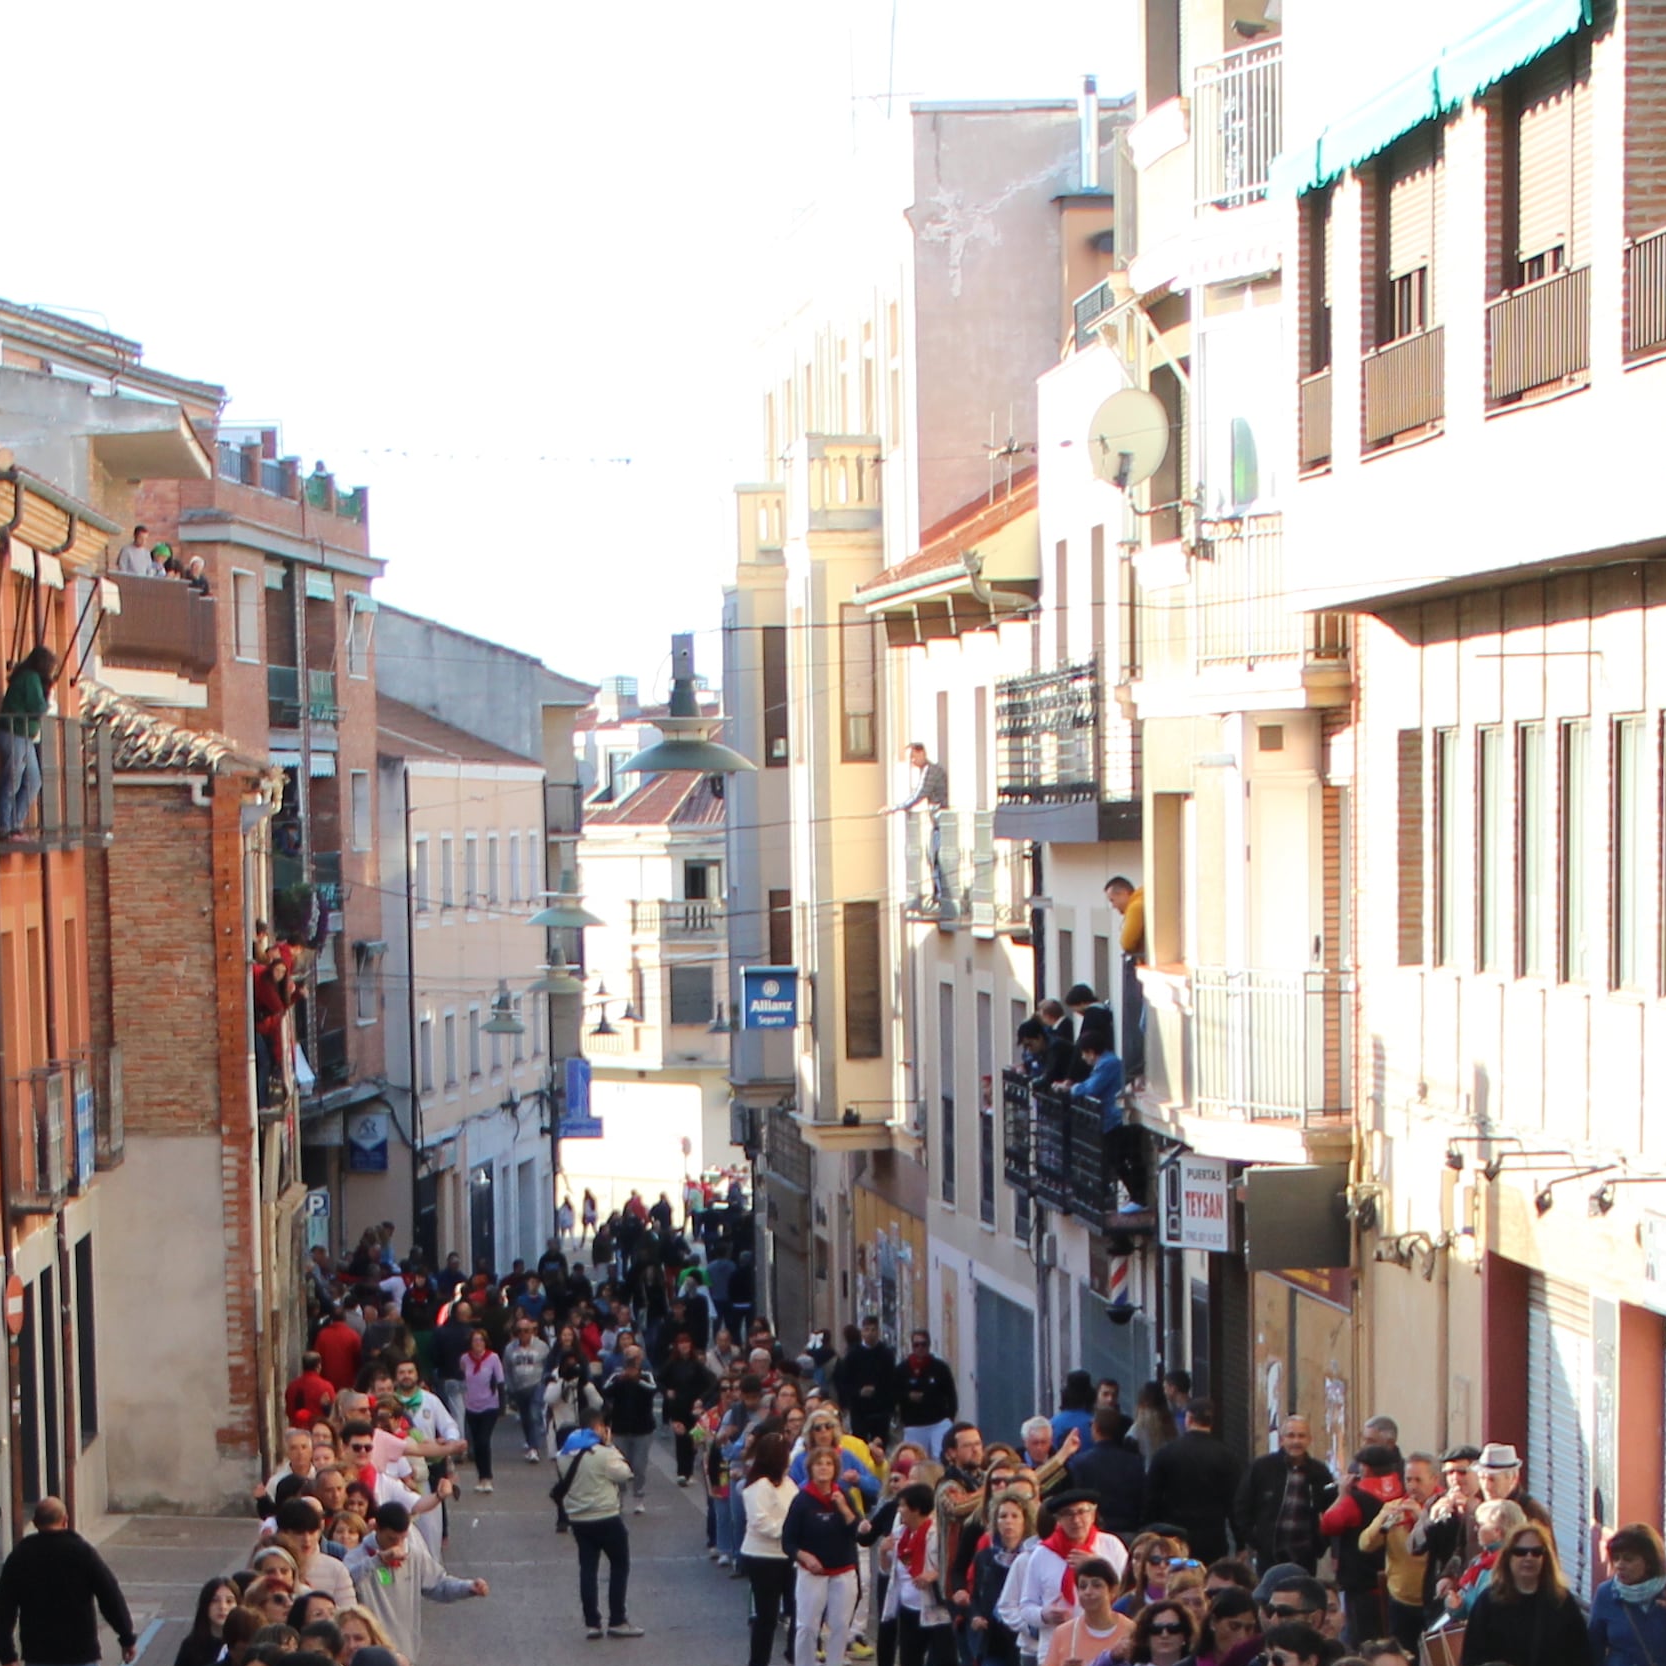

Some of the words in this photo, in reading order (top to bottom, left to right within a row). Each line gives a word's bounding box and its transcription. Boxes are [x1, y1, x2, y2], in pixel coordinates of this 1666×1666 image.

[750, 998, 793, 1013] Allianz
[1186, 1167, 1223, 1182] PUERTAS
[309, 1194, 325, 1216] P
[1185, 1190, 1224, 1221] TEYSAN
